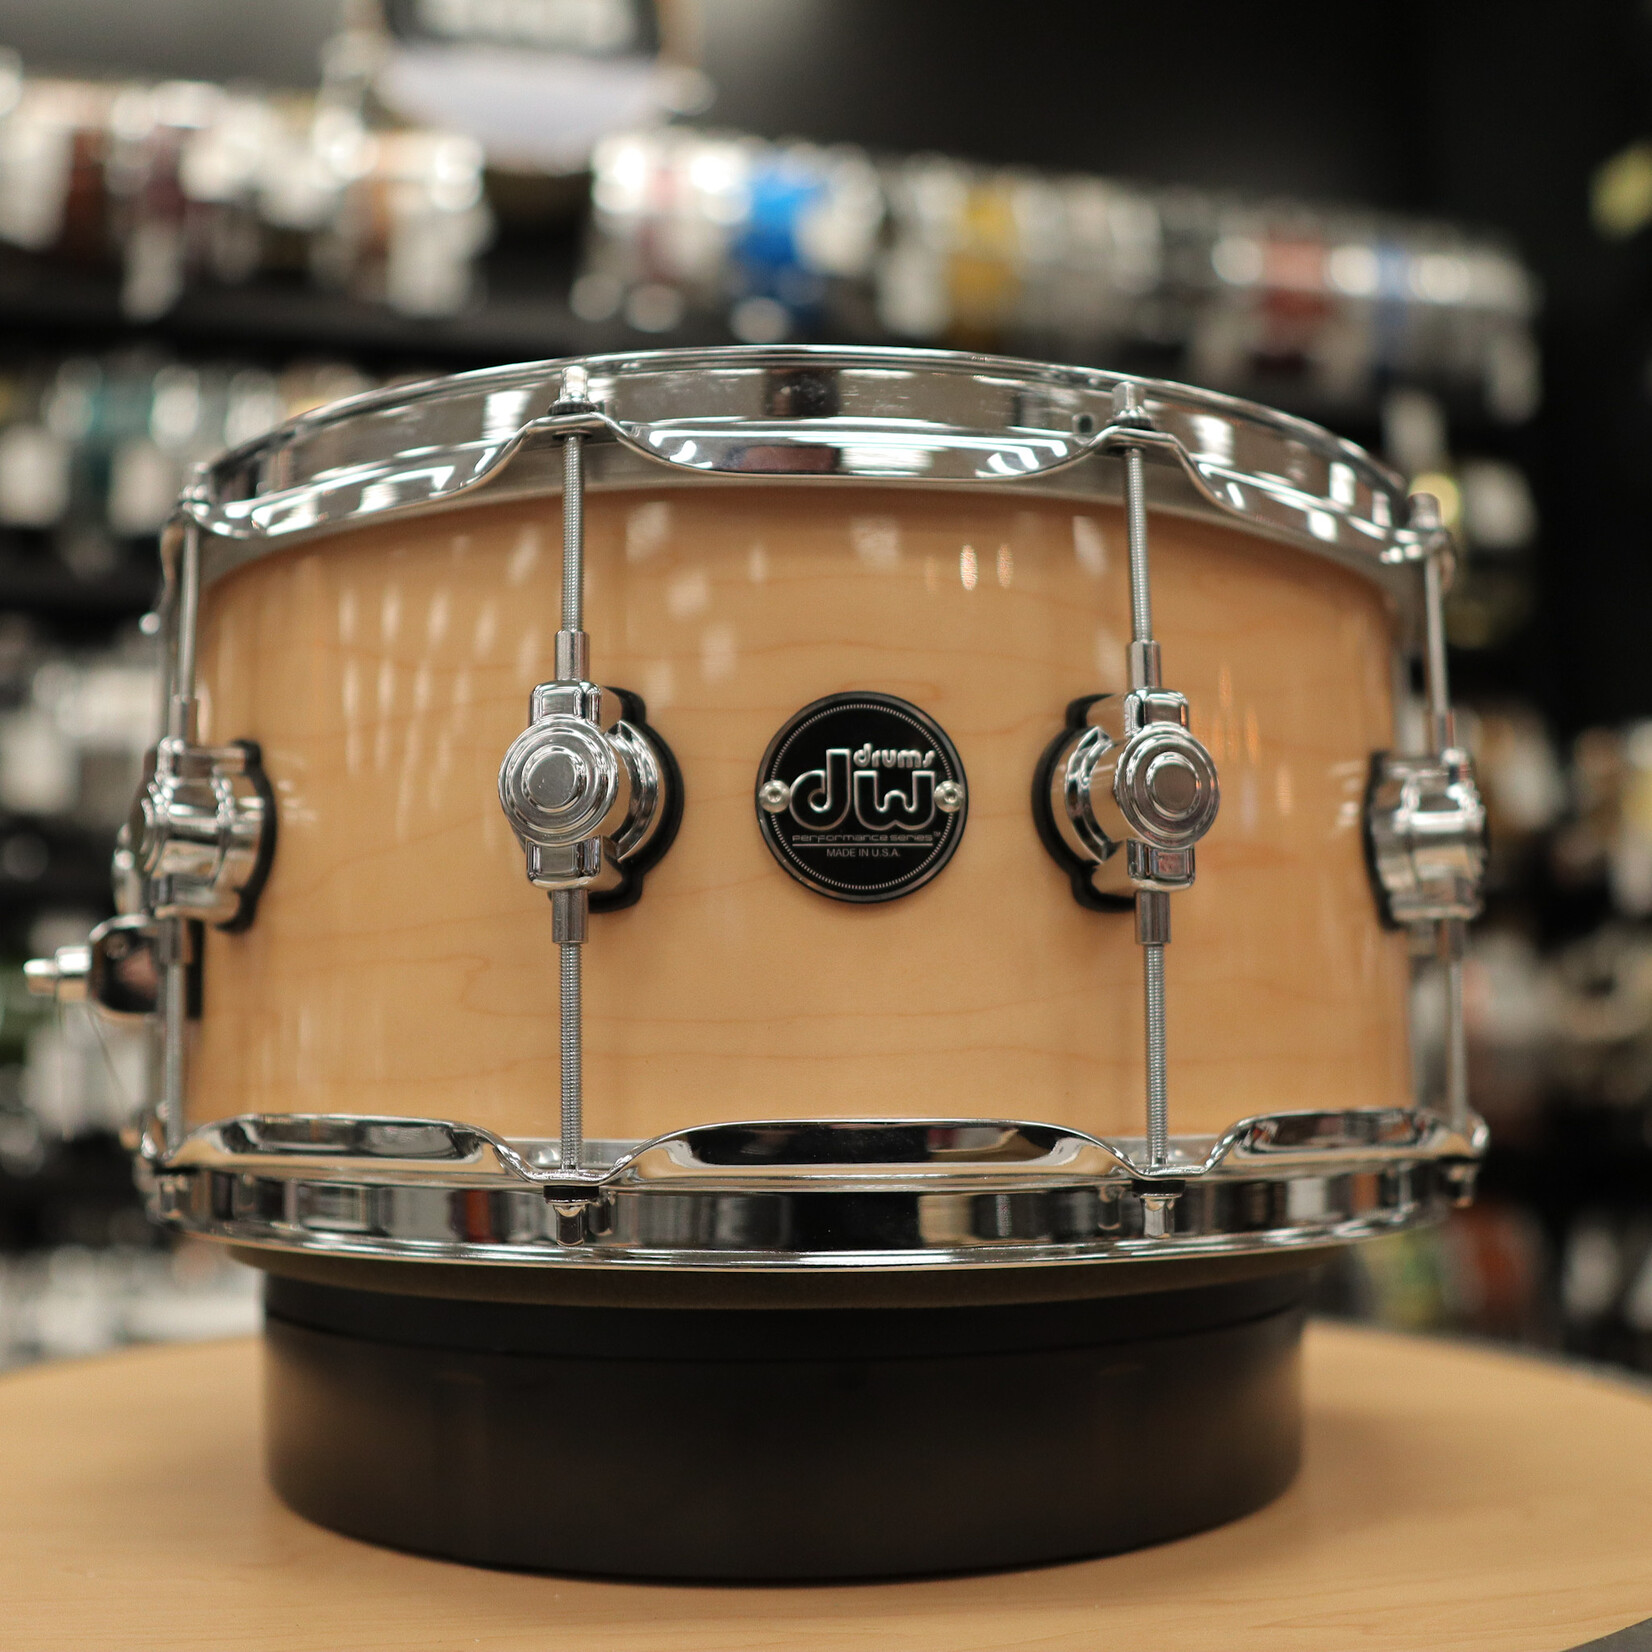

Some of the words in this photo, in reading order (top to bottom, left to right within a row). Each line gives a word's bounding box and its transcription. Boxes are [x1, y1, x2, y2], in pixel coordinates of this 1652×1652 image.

[853, 742, 936, 768] drums
[789, 748, 936, 832] dw
[826, 848, 856, 858] MADE
[858, 848, 869, 858] IN
